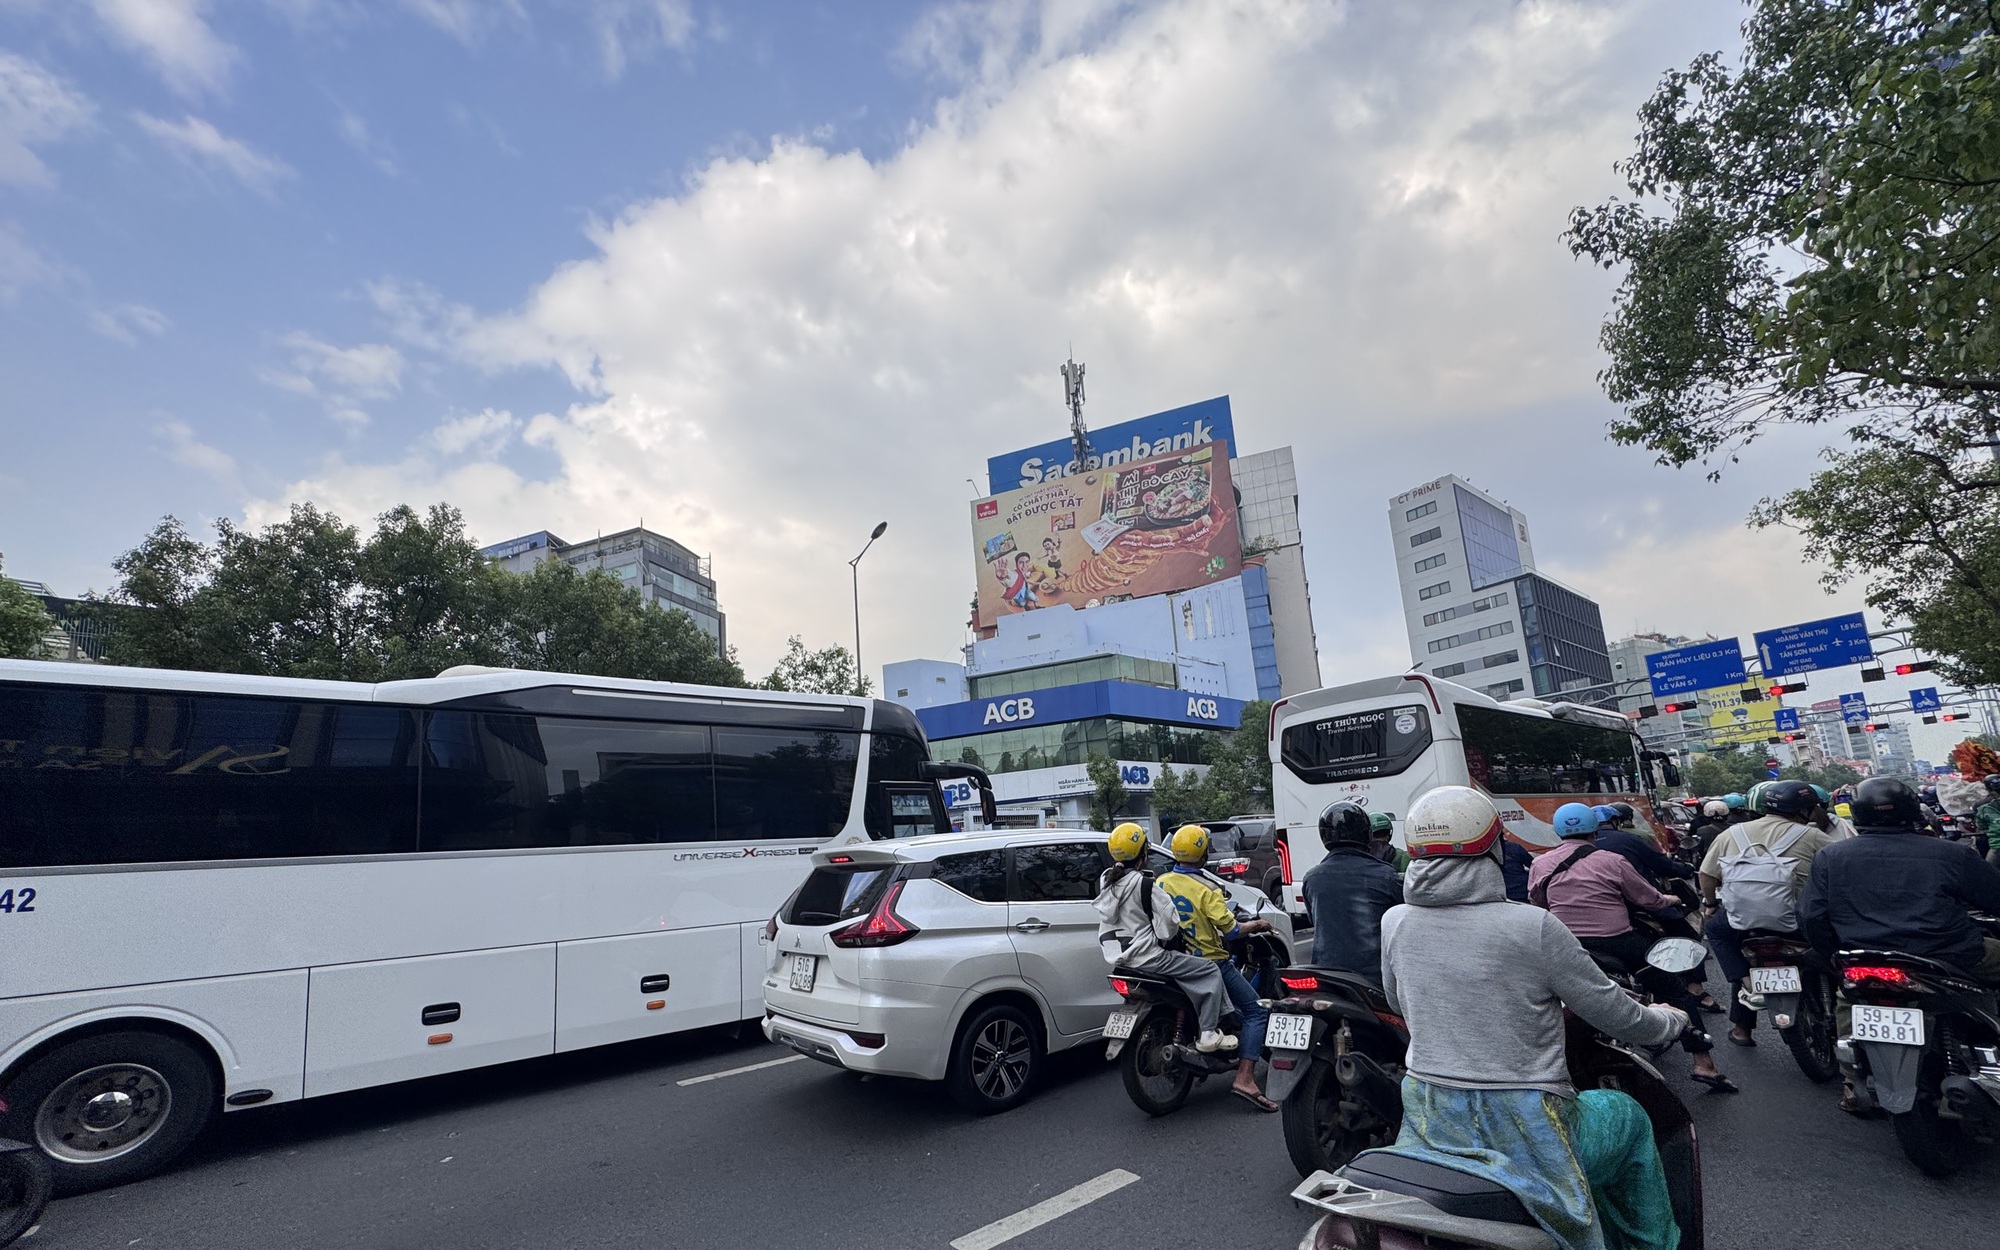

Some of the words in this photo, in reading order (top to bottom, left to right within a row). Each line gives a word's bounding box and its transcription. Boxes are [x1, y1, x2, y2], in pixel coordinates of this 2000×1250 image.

[1142, 475, 1160, 489] BÒ
[1161, 468, 1190, 484] CAY
[1397, 493, 1410, 504] CT
[1412, 481, 1441, 499] PRIME
[978, 509, 997, 518] VIFON
[1025, 500, 1057, 517] ĐƯỢC
[1060, 493, 1084, 509] TẤT
[1775, 633, 1799, 643] HOÀNG
[1814, 628, 1828, 636] THỤ
[1853, 638, 1867, 646] Km
[1676, 657, 1692, 665] HUY
[1693, 651, 1711, 662] LIỆU
[1724, 648, 1739, 656] Km
[1730, 671, 1744, 679] Km
[983, 697, 1035, 725] ACB
[1186, 696, 1219, 720] ACB
[1316, 722, 1332, 730] CTY
[1334, 716, 1357, 727] THÚY
[1360, 712, 1385, 724] NGỌC
[1347, 724, 1372, 732] Services
[1121, 766, 1149, 785] ACB
[0, 887, 36, 913] 42
[797, 958, 810, 973] 51G
[1757, 968, 1792, 981] 77-L2
[1755, 979, 1798, 992] 042.90
[1274, 1016, 1306, 1031] 59-T2
[1863, 1008, 1912, 1026] 59-L2
[1268, 1031, 1307, 1047] 314.15
[1857, 1022, 1918, 1042] 358.81
